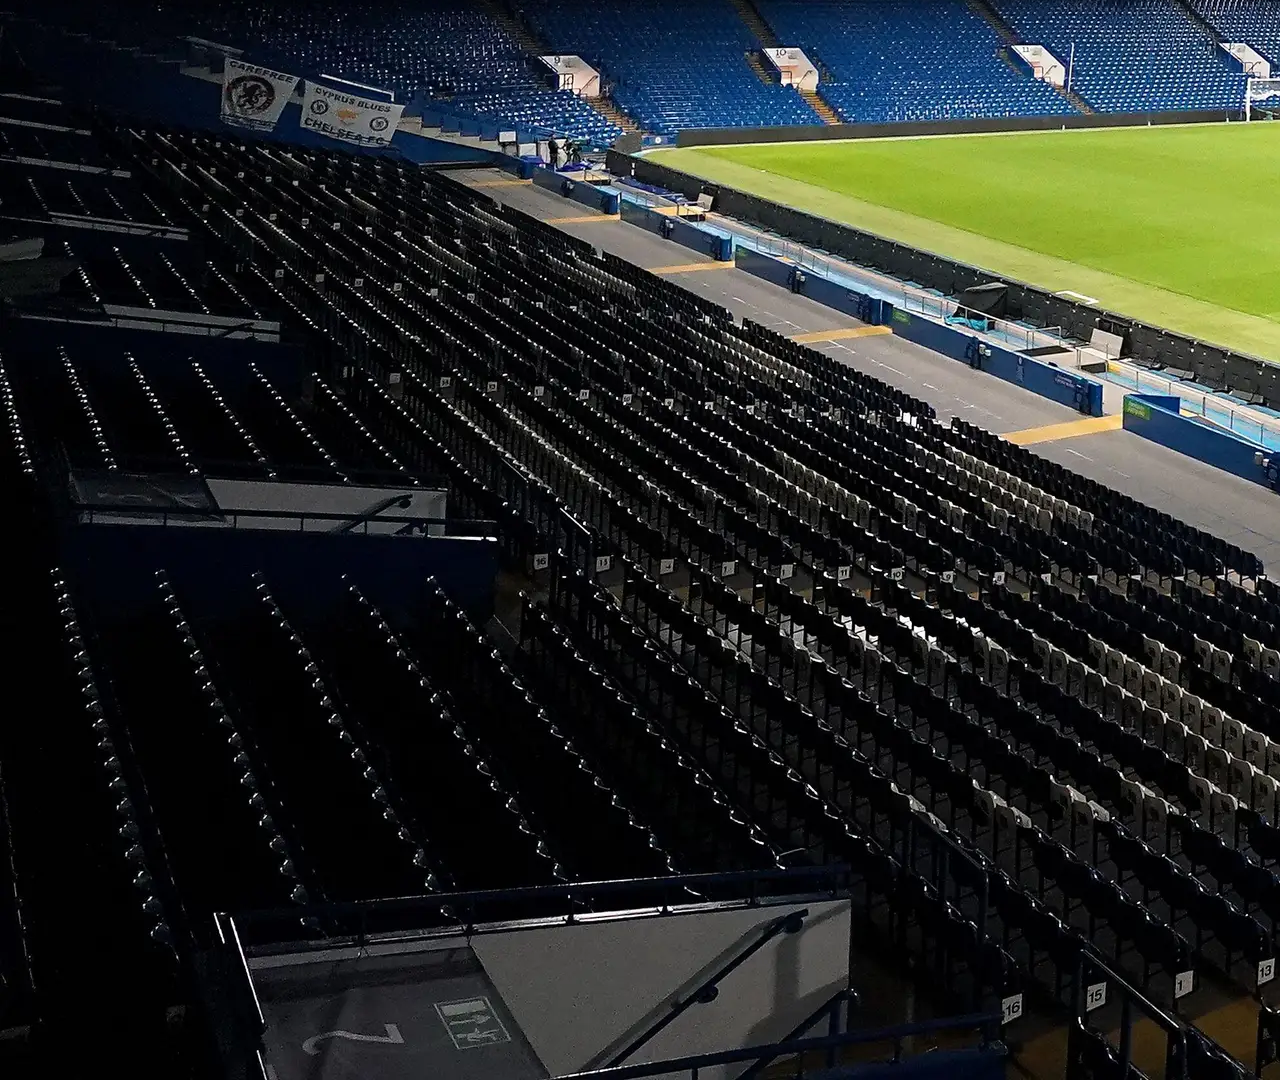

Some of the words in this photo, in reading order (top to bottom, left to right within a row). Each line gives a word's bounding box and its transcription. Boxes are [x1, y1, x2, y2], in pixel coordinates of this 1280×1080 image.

[554, 56, 560, 64] 9
[229, 60, 294, 84] CAREFREE
[315, 86, 355, 106] CYPRUS
[356, 100, 391, 113] BLUES
[304, 117, 364, 141] CHELSEA
[1259, 965, 1271, 978] 13
[1088, 989, 1102, 1003] 15
[1006, 1001, 1020, 1016] 16
